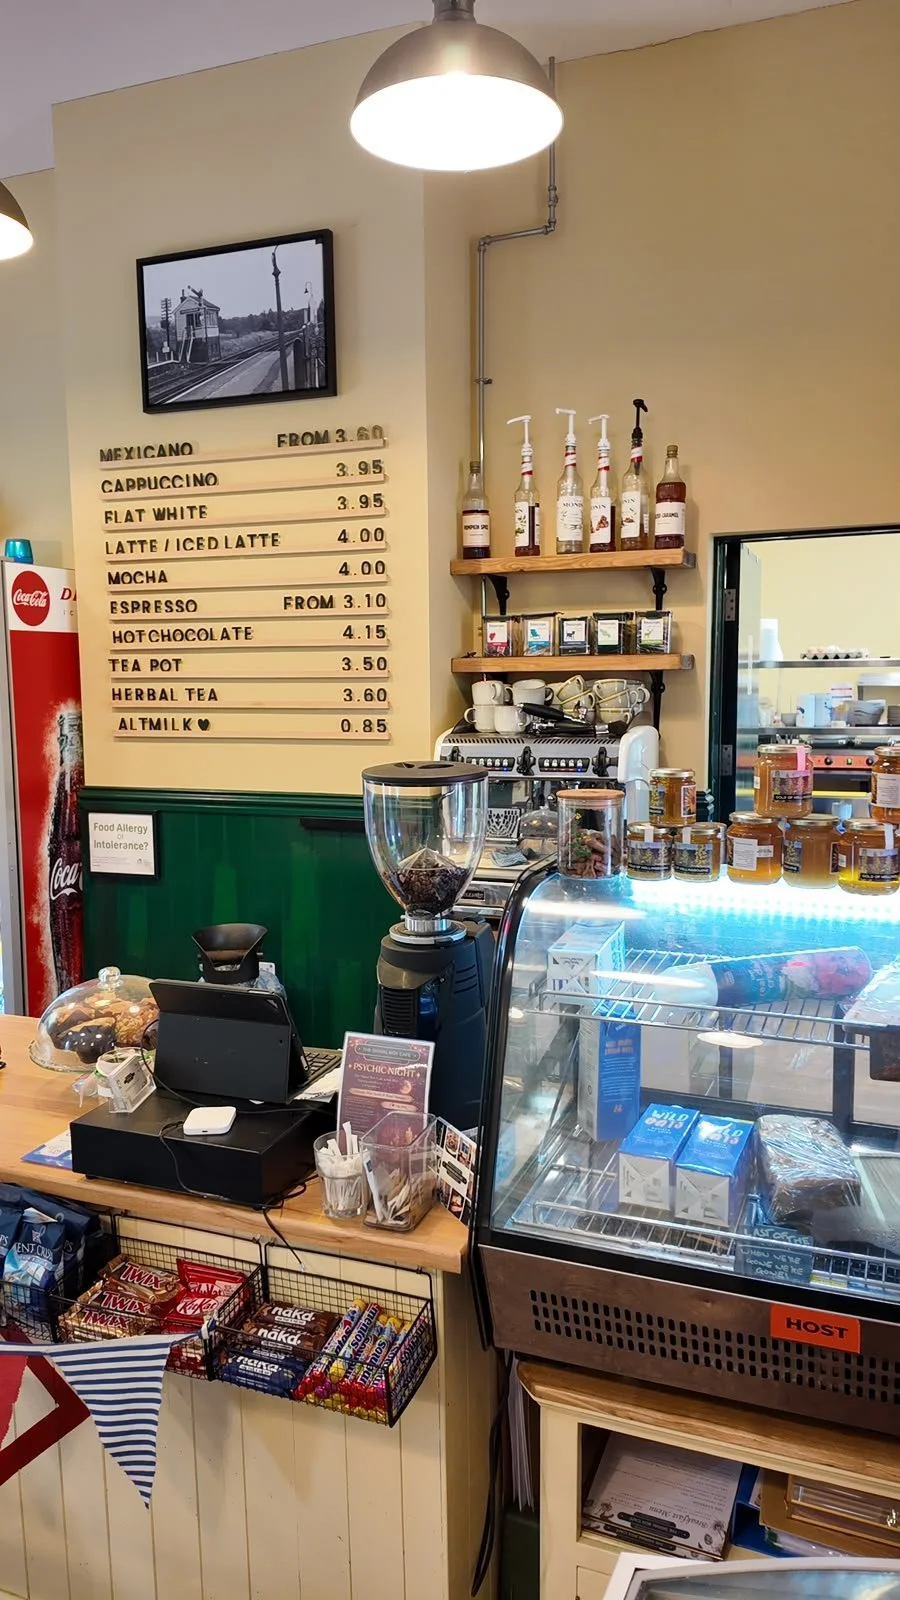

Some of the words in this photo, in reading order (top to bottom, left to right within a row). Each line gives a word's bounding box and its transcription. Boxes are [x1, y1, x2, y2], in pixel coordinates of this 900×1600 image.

[100, 442, 193, 462] MEXICANO
[277, 430, 329, 448] FROM
[335, 425, 384, 444] 3.60
[101, 473, 218, 493] CAPPUCCINO
[336, 459, 383, 477] 3.95
[104, 509, 145, 524] FLAT
[153, 505, 208, 521] WHITE
[337, 493, 383, 511] 3.95
[105, 539, 157, 555] LATTE
[164, 539, 169, 552] /
[176, 536, 219, 551] ICED
[225, 533, 280, 549] LATTE
[337, 527, 385, 544] 4.00
[108, 570, 168, 585] MOCHA
[339, 560, 386, 576] 4.00
[110, 599, 198, 614] ESPRESSO
[283, 595, 334, 610] FROM
[343, 593, 386, 609] 3.10
[342, 625, 386, 640] 4.15
[108, 659, 141, 672] TEA
[150, 658, 182, 672] POT
[342, 657, 387, 671] 3.50
[111, 687, 178, 701] HERBAL
[185, 687, 218, 701] TEA
[343, 689, 387, 702] 3.60
[341, 719, 387, 733] 0.85
[93, 823, 115, 832] Food
[116, 823, 148, 835] Allergy
[93, 840, 149, 850] Intolerance?
[353, 1062, 387, 1075] PSYCHIC
[387, 1067, 416, 1078] NIGHT
[16, 1242, 36, 1254] ENT
[120, 1261, 166, 1290] TWIX
[101, 1291, 151, 1315] TWIX
[350, 1306, 378, 1349] mentos
[785, 1317, 849, 1339] HOST
